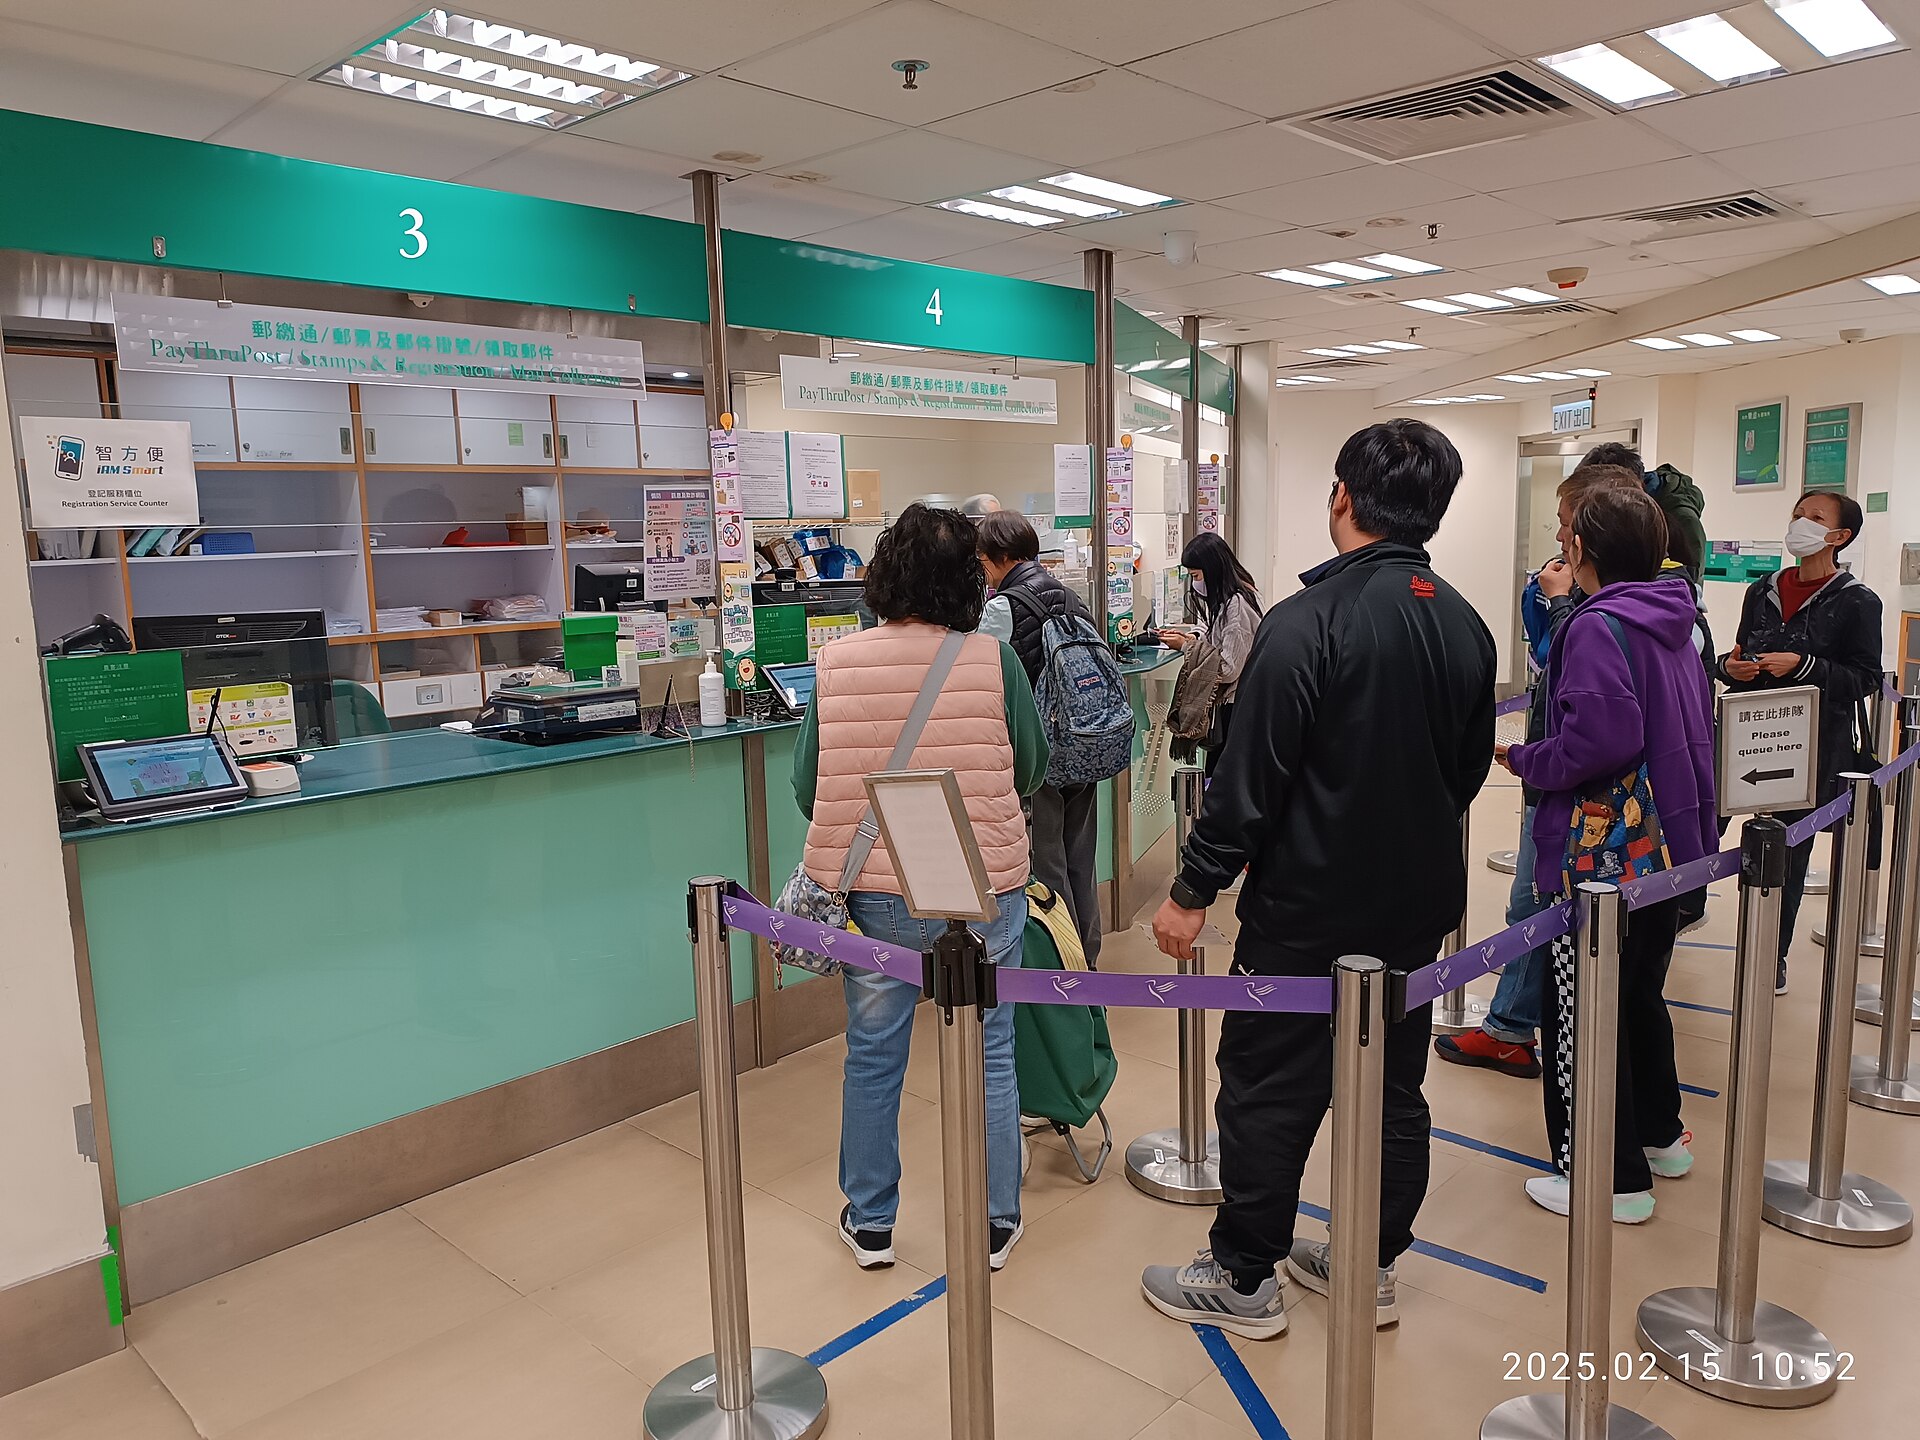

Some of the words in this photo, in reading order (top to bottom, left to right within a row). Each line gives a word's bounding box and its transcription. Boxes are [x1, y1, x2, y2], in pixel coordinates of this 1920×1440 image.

[399, 207, 428, 259] 3
[925, 288, 943, 325] 4
[150, 338, 282, 364] PayThruPost
[299, 349, 367, 373] Stamps
[371, 356, 387, 372] &
[850, 371, 1008, 396] 郵繳通/郵票及郵件掛號/領取郵件
[799, 385, 865, 404] PayThruPost
[873, 391, 908, 408] Stamps
[910, 393, 920, 406] &
[1554, 410, 1573, 431] EXIT
[1574, 407, 1590, 427] 出口
[95, 445, 165, 462] 智方便
[123, 465, 163, 475] Smart
[62, 500, 109, 509] Registration
[110, 500, 138, 508] Service
[1410, 575, 1435, 591] Leica
[1738, 705, 1804, 723] 請在此排隊
[1751, 730, 1791, 740] Please
[1738, 746, 1773, 757] queue
[1776, 743, 1803, 752] here
